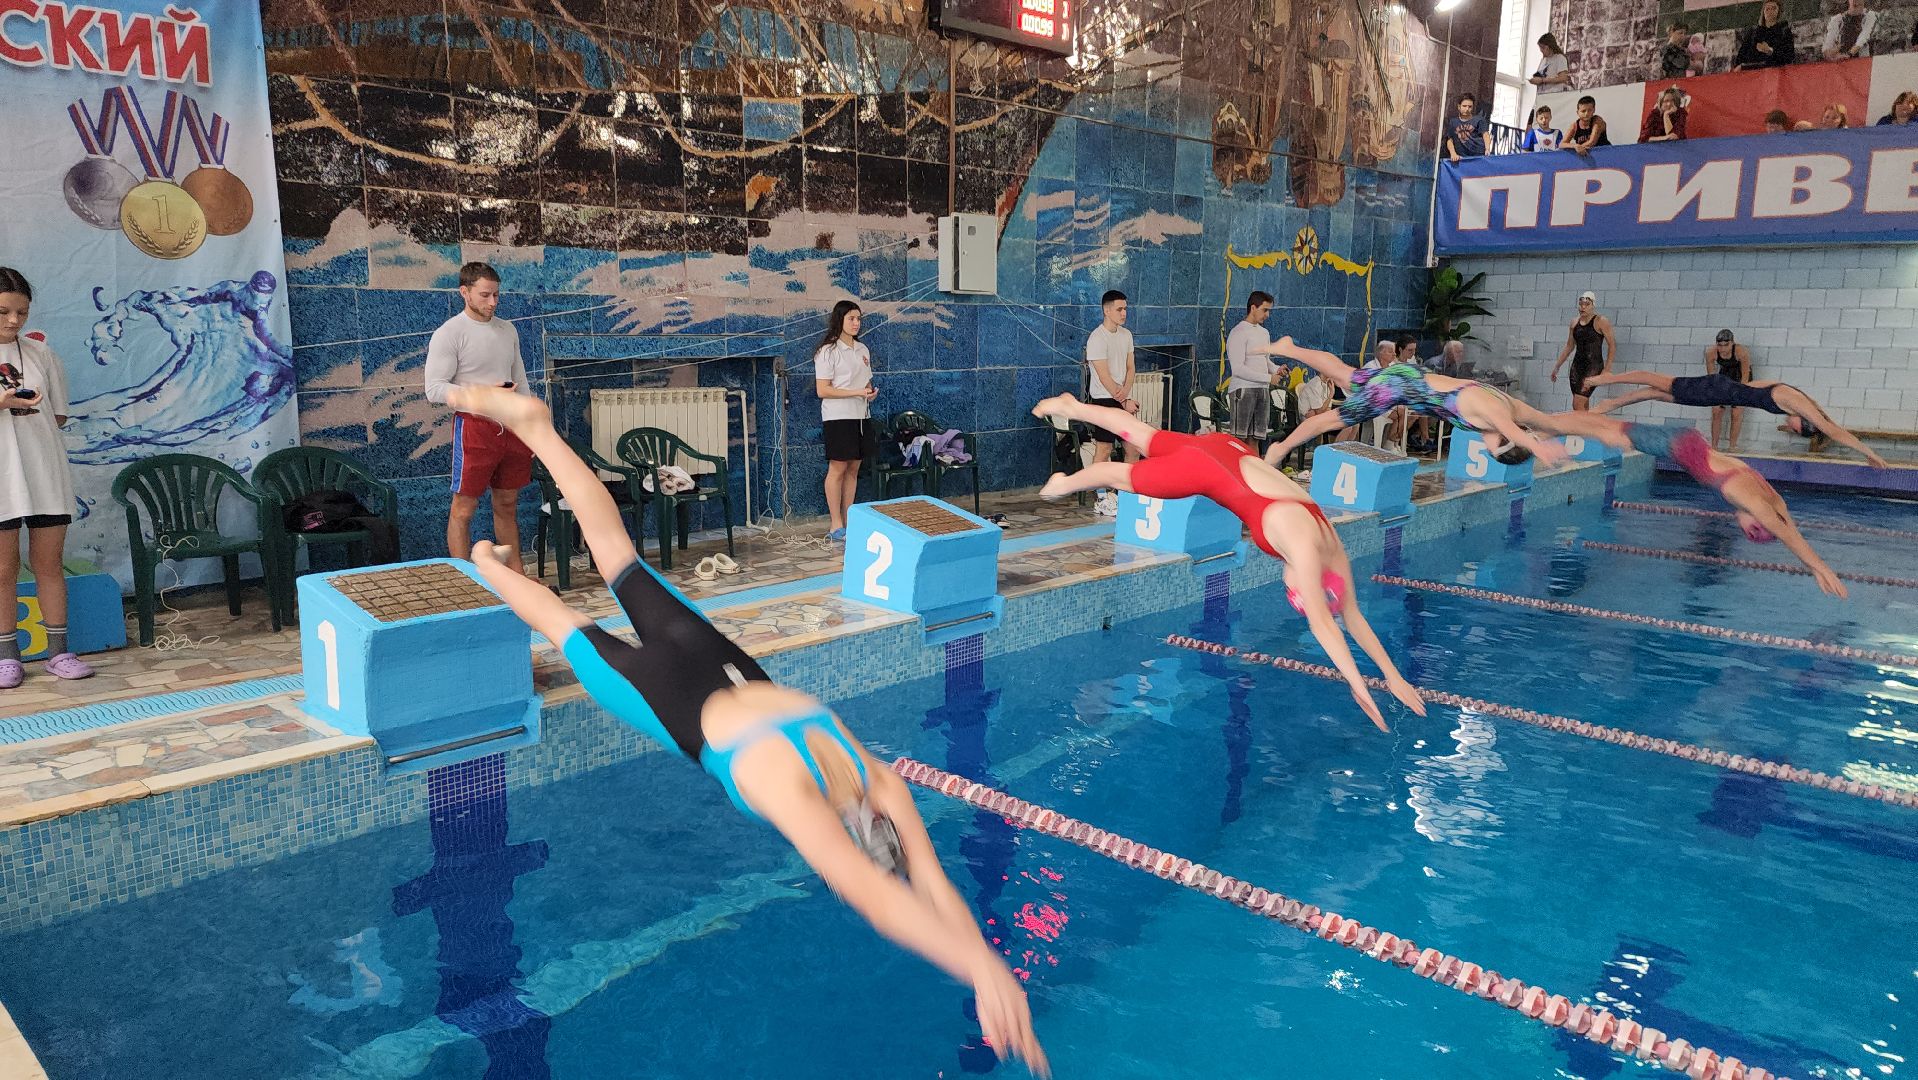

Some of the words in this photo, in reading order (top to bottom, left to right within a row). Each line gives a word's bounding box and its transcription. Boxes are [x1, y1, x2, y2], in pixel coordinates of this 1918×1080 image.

[1458, 147, 1918, 231] ПРИВЕ
[152, 194, 173, 234] 1
[1466, 440, 1489, 478] 5
[1332, 462, 1358, 504] 4
[1135, 494, 1164, 541] 3
[863, 530, 893, 600] 2
[317, 619, 340, 711] 1
